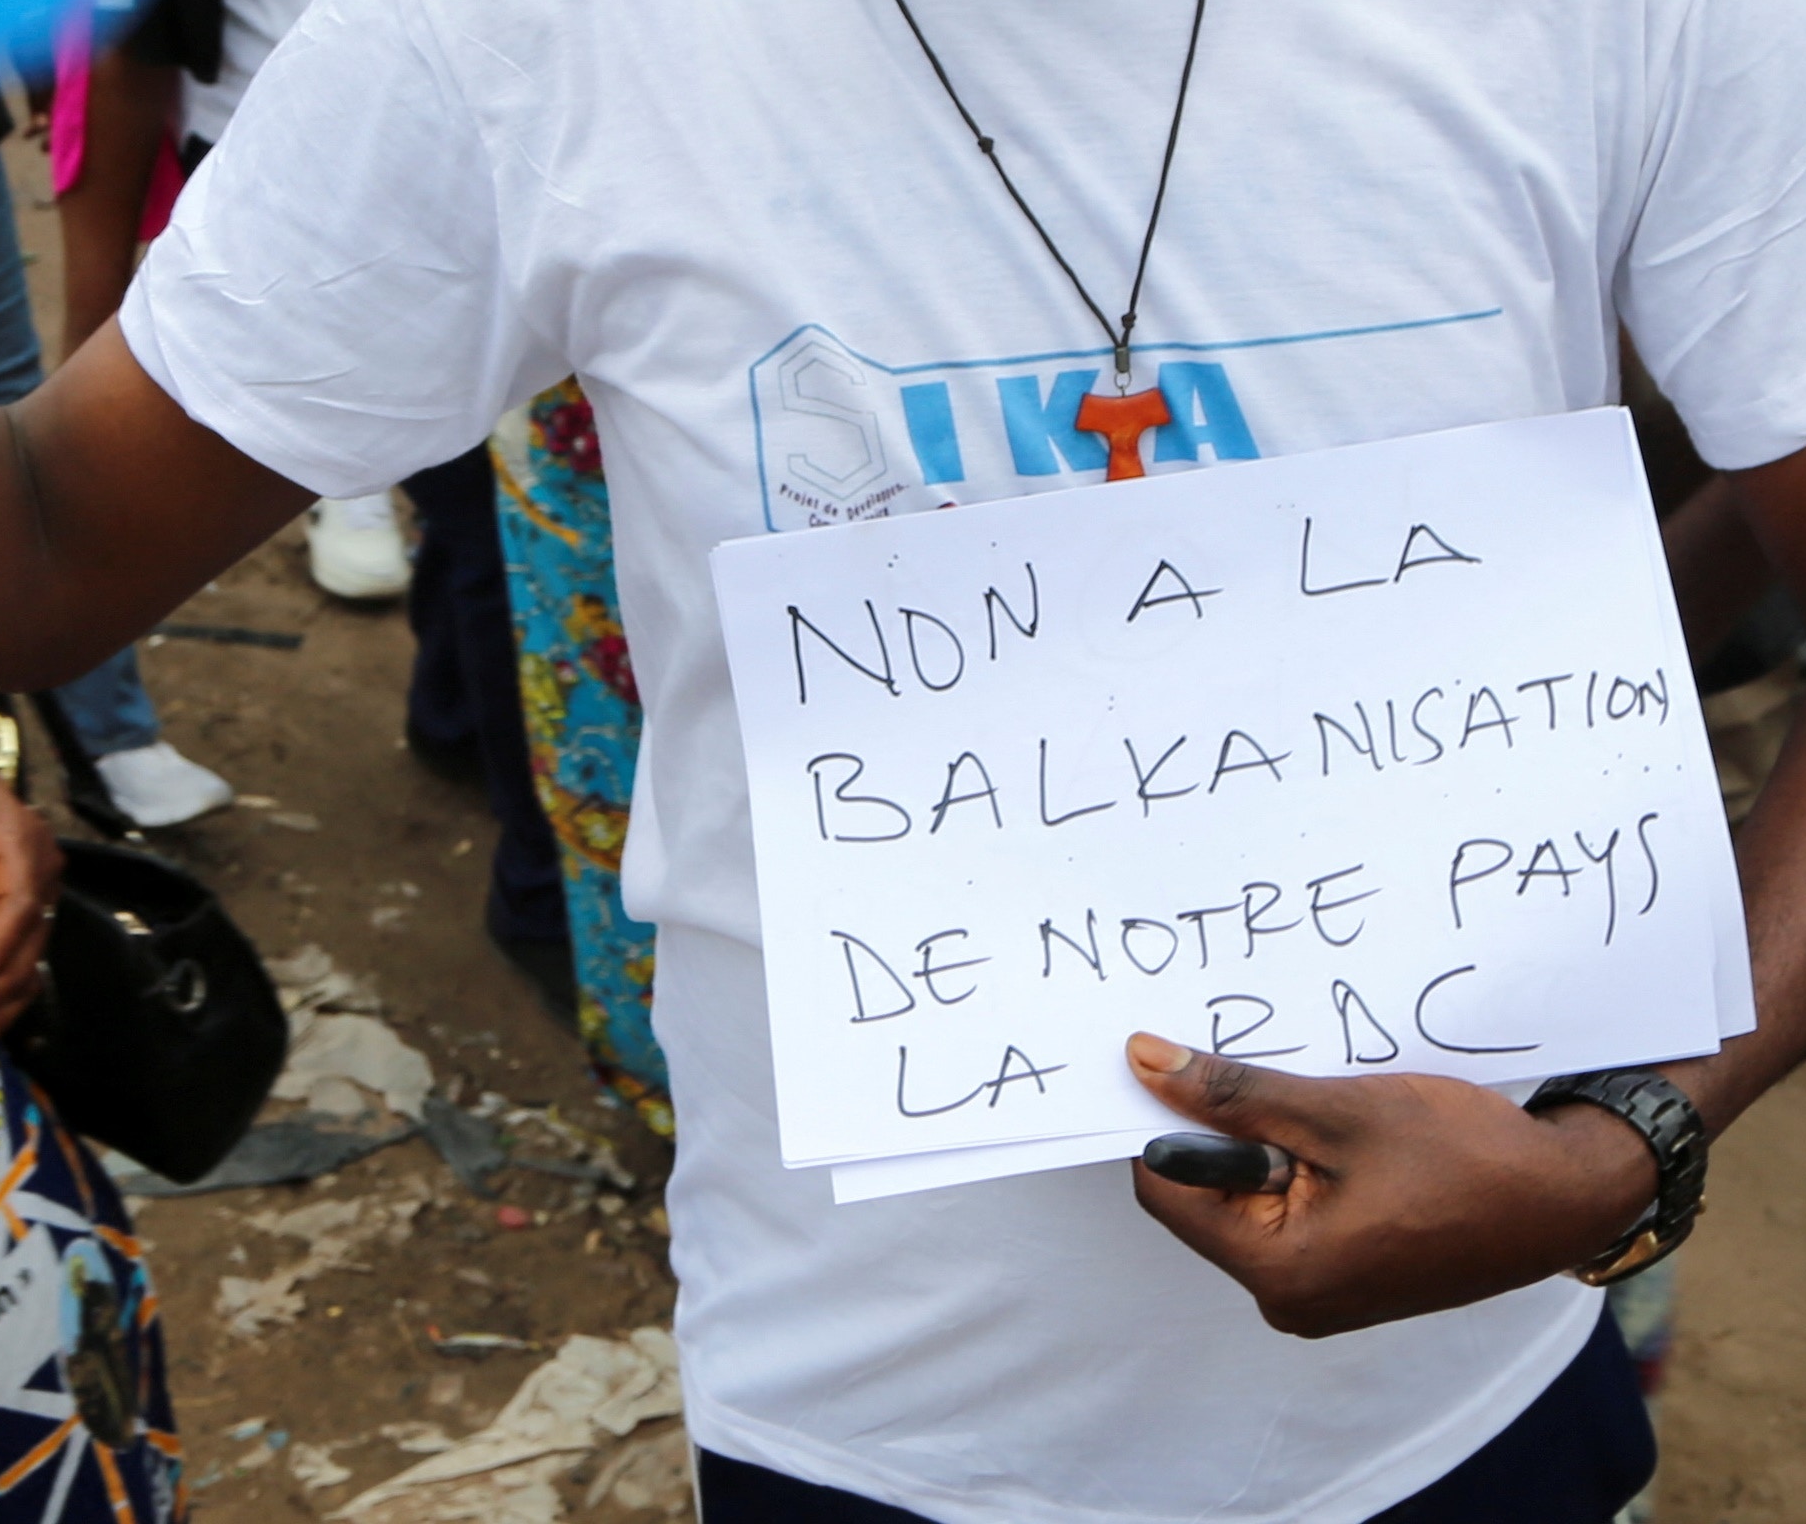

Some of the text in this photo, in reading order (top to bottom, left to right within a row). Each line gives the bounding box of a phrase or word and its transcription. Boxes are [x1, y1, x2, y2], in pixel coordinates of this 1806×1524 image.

[787, 516, 1482, 704] NON A LA
[807, 667, 1669, 842] BALKANISATION
[830, 812, 1659, 1023] DE NOTRE PAYS
[898, 964, 1543, 1118] LA RDC
